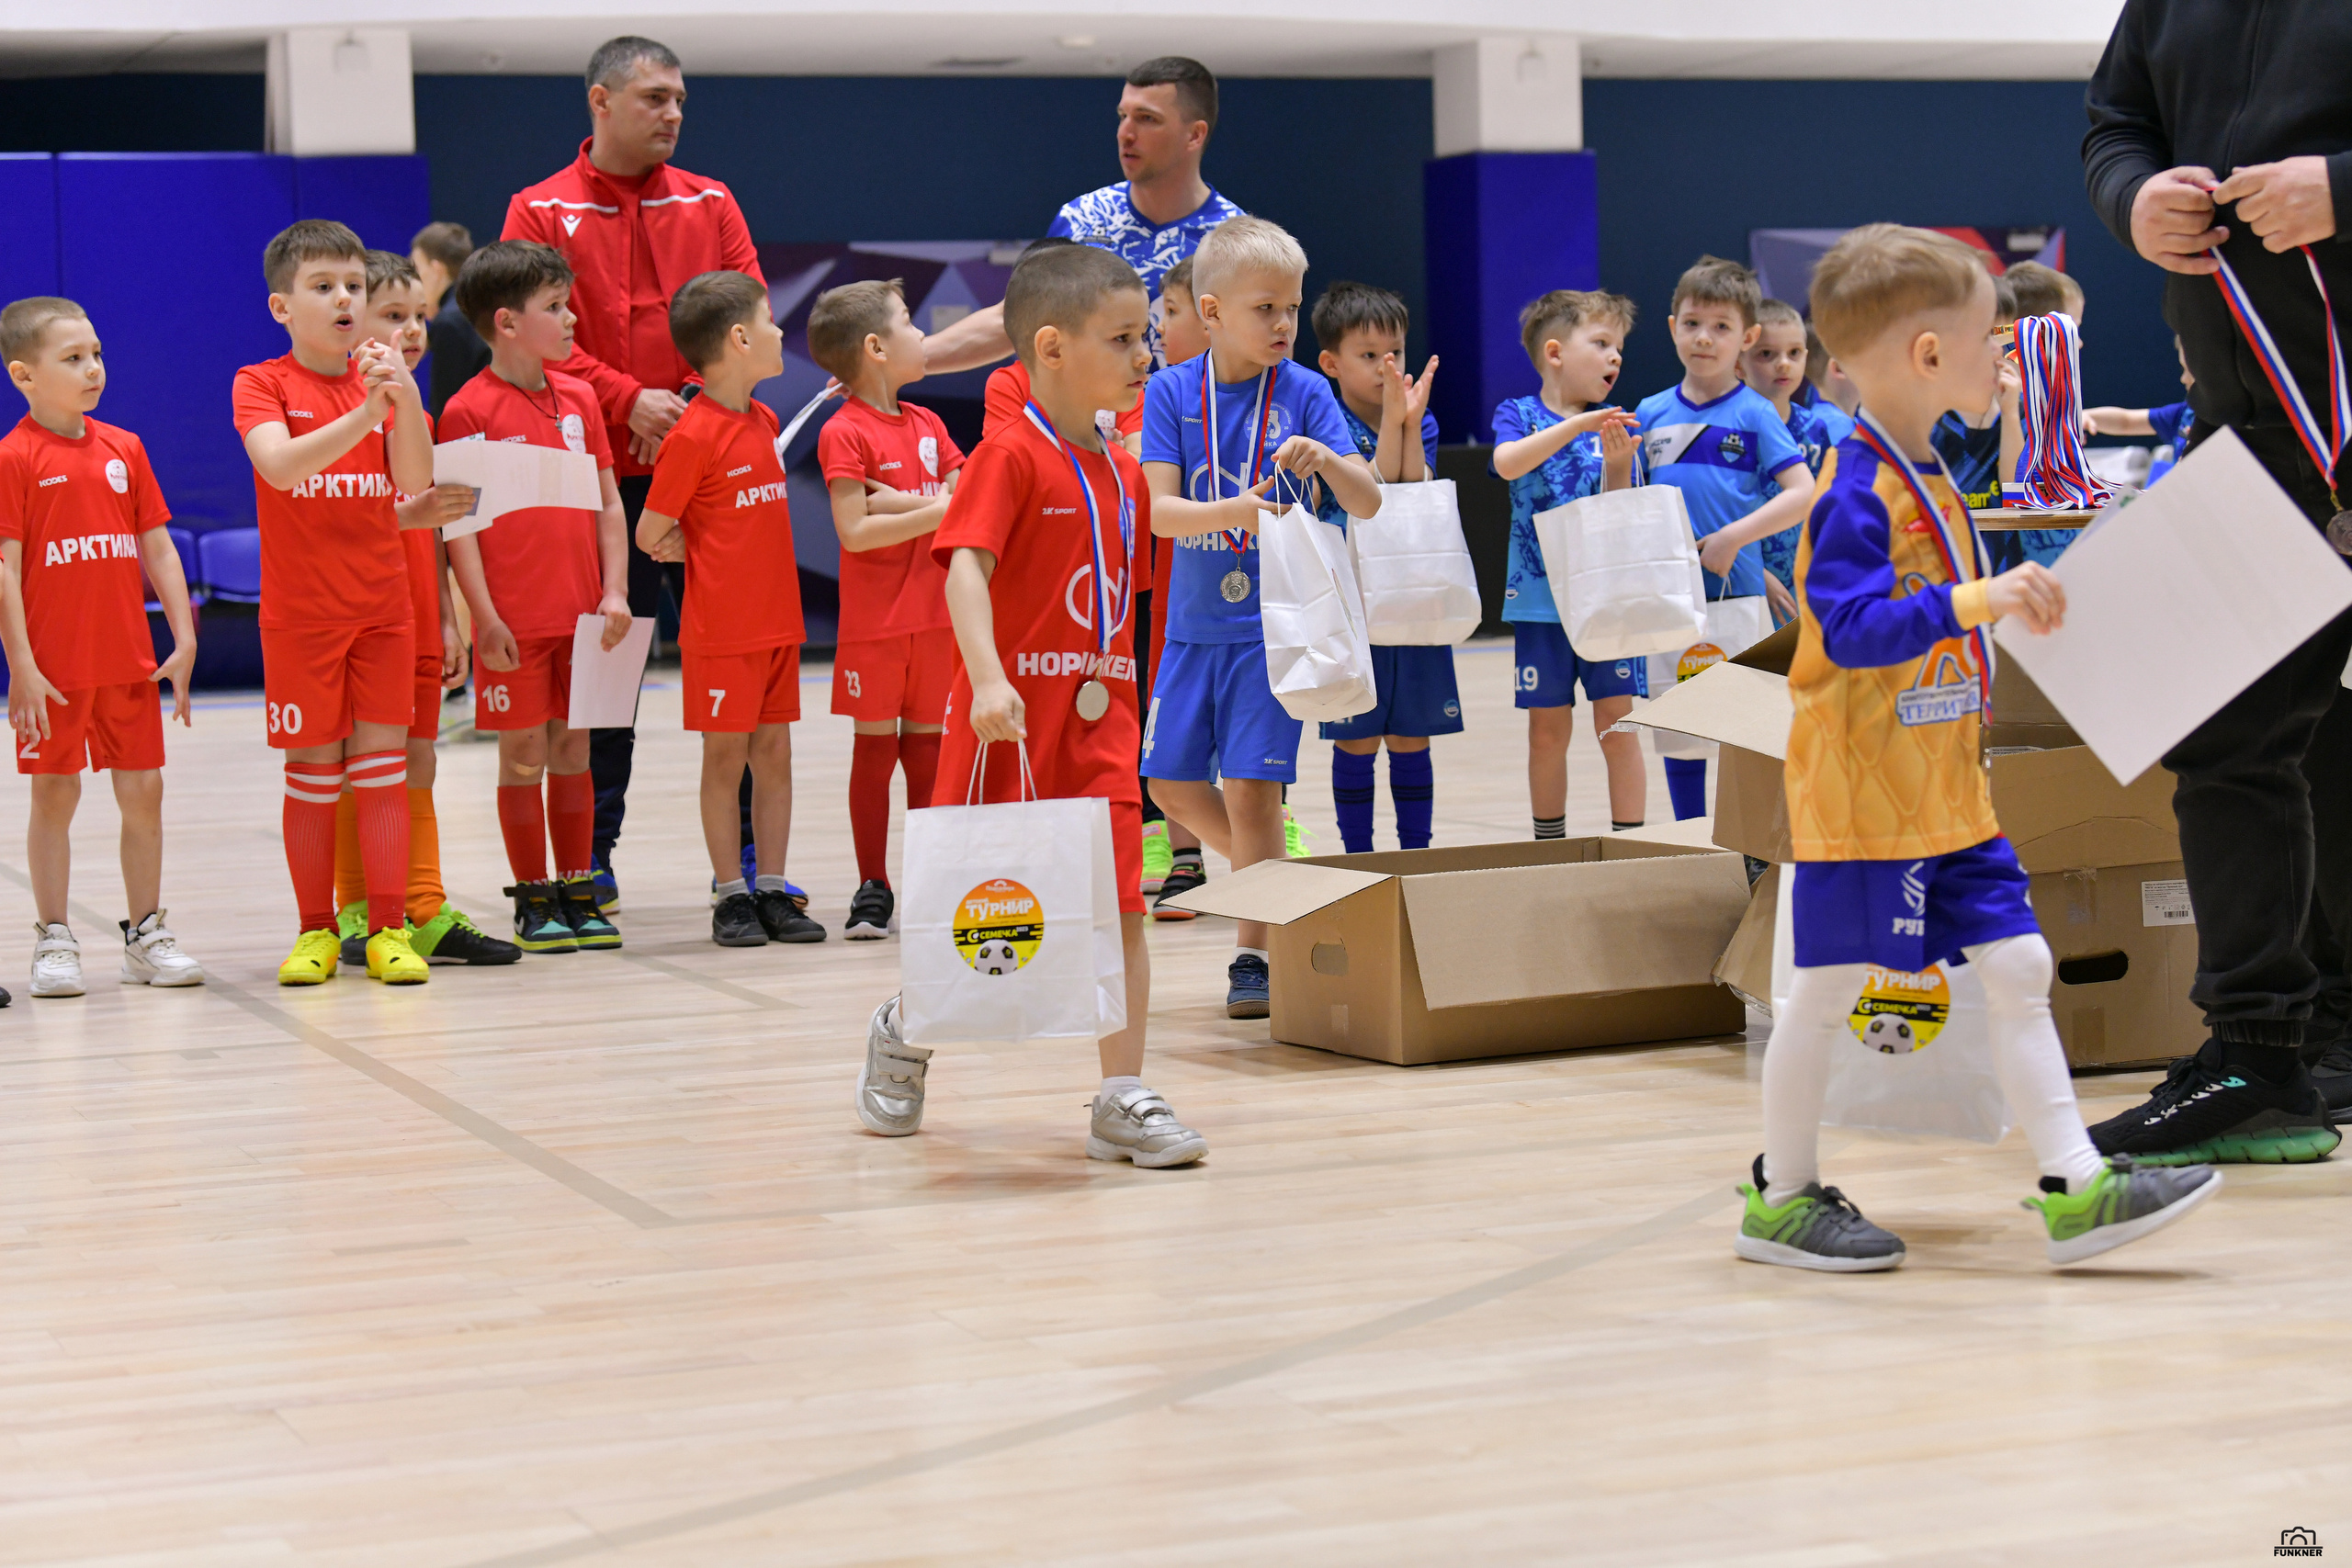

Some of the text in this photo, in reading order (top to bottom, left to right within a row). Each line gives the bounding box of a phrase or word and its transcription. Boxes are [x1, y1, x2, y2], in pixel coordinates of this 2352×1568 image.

[39, 475, 68, 488] KODES
[727, 465, 752, 478] KODES
[45, 534, 138, 567] АРКТИКА
[844, 669, 862, 698] 23
[1514, 666, 1539, 691] 19
[481, 684, 511, 713] 16
[708, 688, 726, 717] 7
[268, 701, 303, 735] 30
[965, 899, 1035, 921] ТУРНИР
[979, 930, 1018, 940] СЕМЕЧКА
